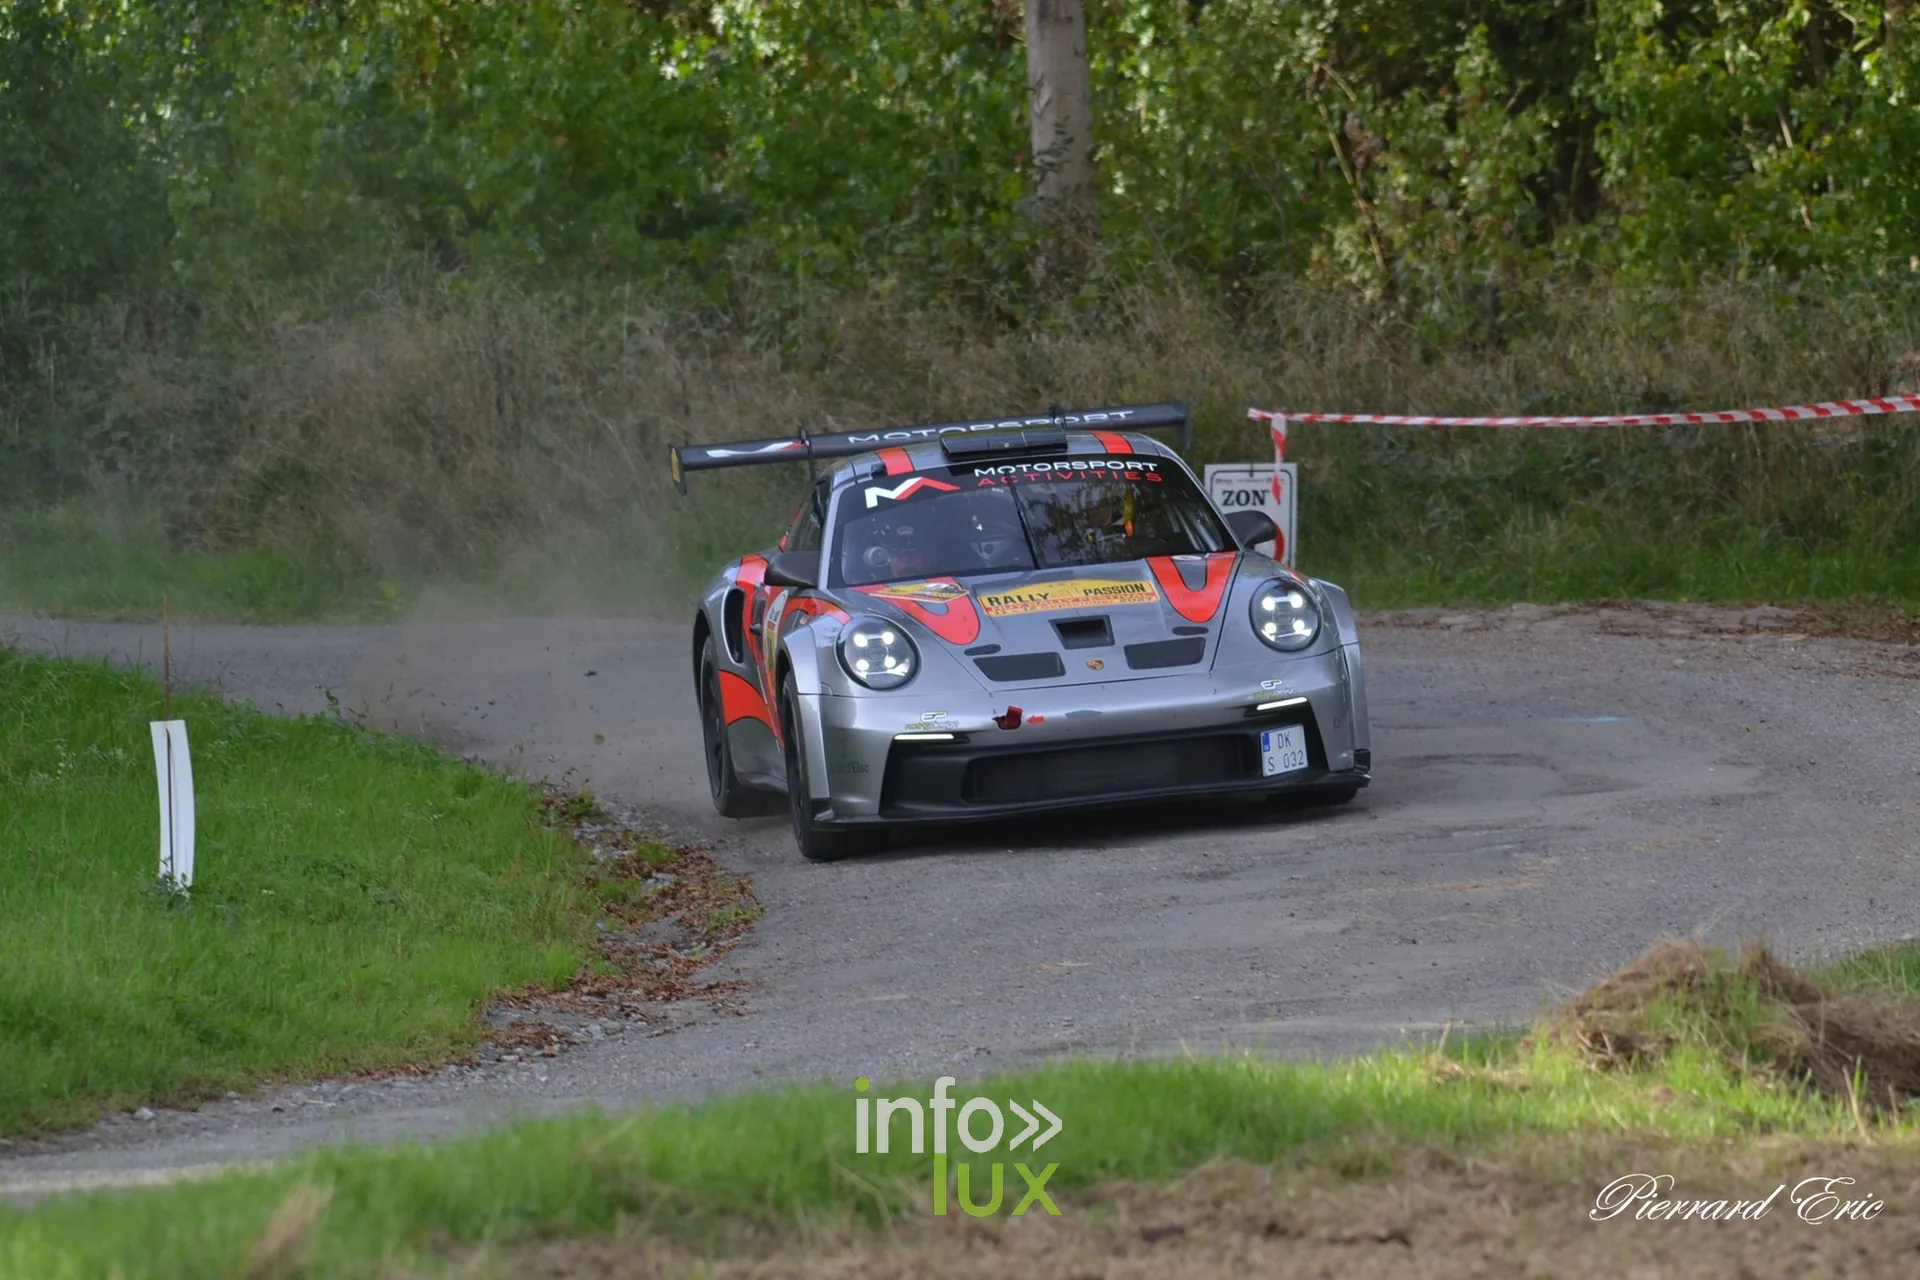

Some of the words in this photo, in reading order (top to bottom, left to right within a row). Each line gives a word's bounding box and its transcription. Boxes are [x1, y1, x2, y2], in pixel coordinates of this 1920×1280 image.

[974, 460, 1158, 478] MOTORSPORT
[978, 471, 1163, 487] ACTIVITIES
[1222, 489, 1281, 506] ZON
[986, 592, 1050, 606] RALLY
[1083, 583, 1146, 597] PASSION
[920, 711, 948, 722] EP
[1277, 731, 1292, 749] DK
[1267, 756, 1276, 772] S
[1283, 749, 1305, 769] 032
